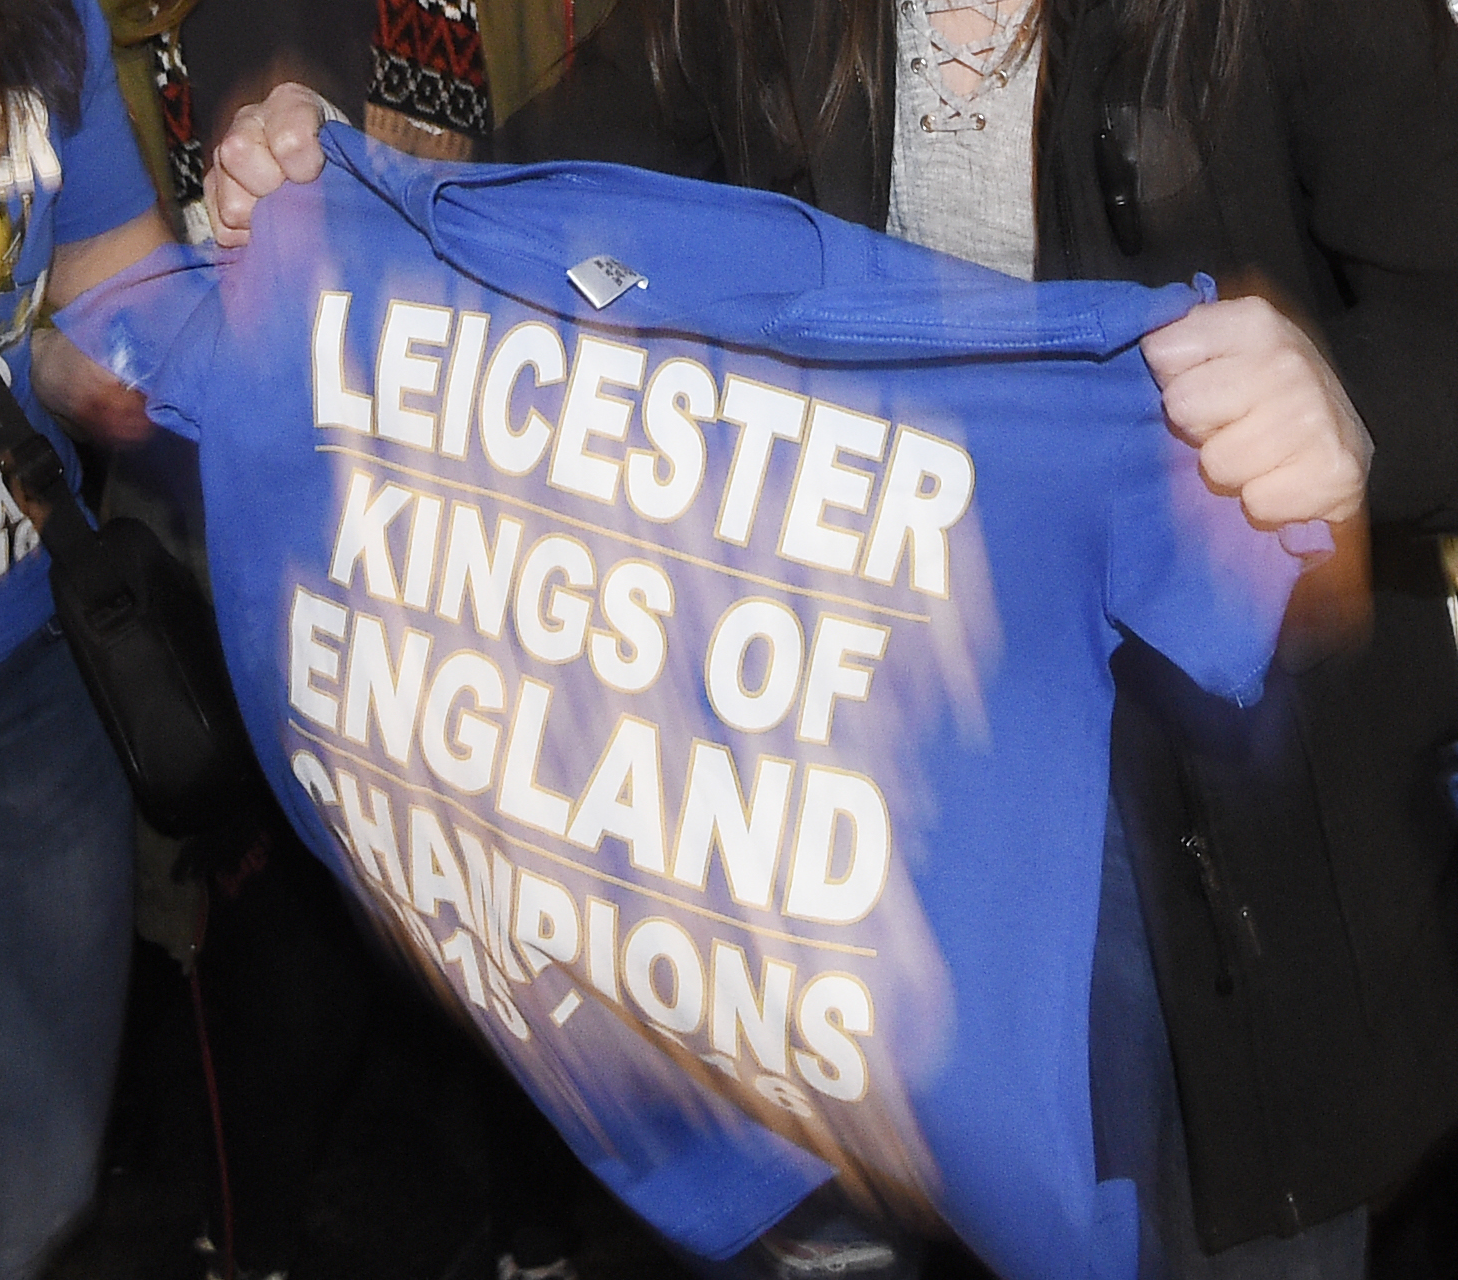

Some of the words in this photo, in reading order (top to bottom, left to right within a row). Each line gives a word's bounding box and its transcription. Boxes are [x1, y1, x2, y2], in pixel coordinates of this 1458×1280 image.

[312, 290, 975, 600] LEICESTER
[288, 584, 891, 925] ENGLAND
[328, 466, 675, 694] KINGS
[704, 595, 892, 746] OF
